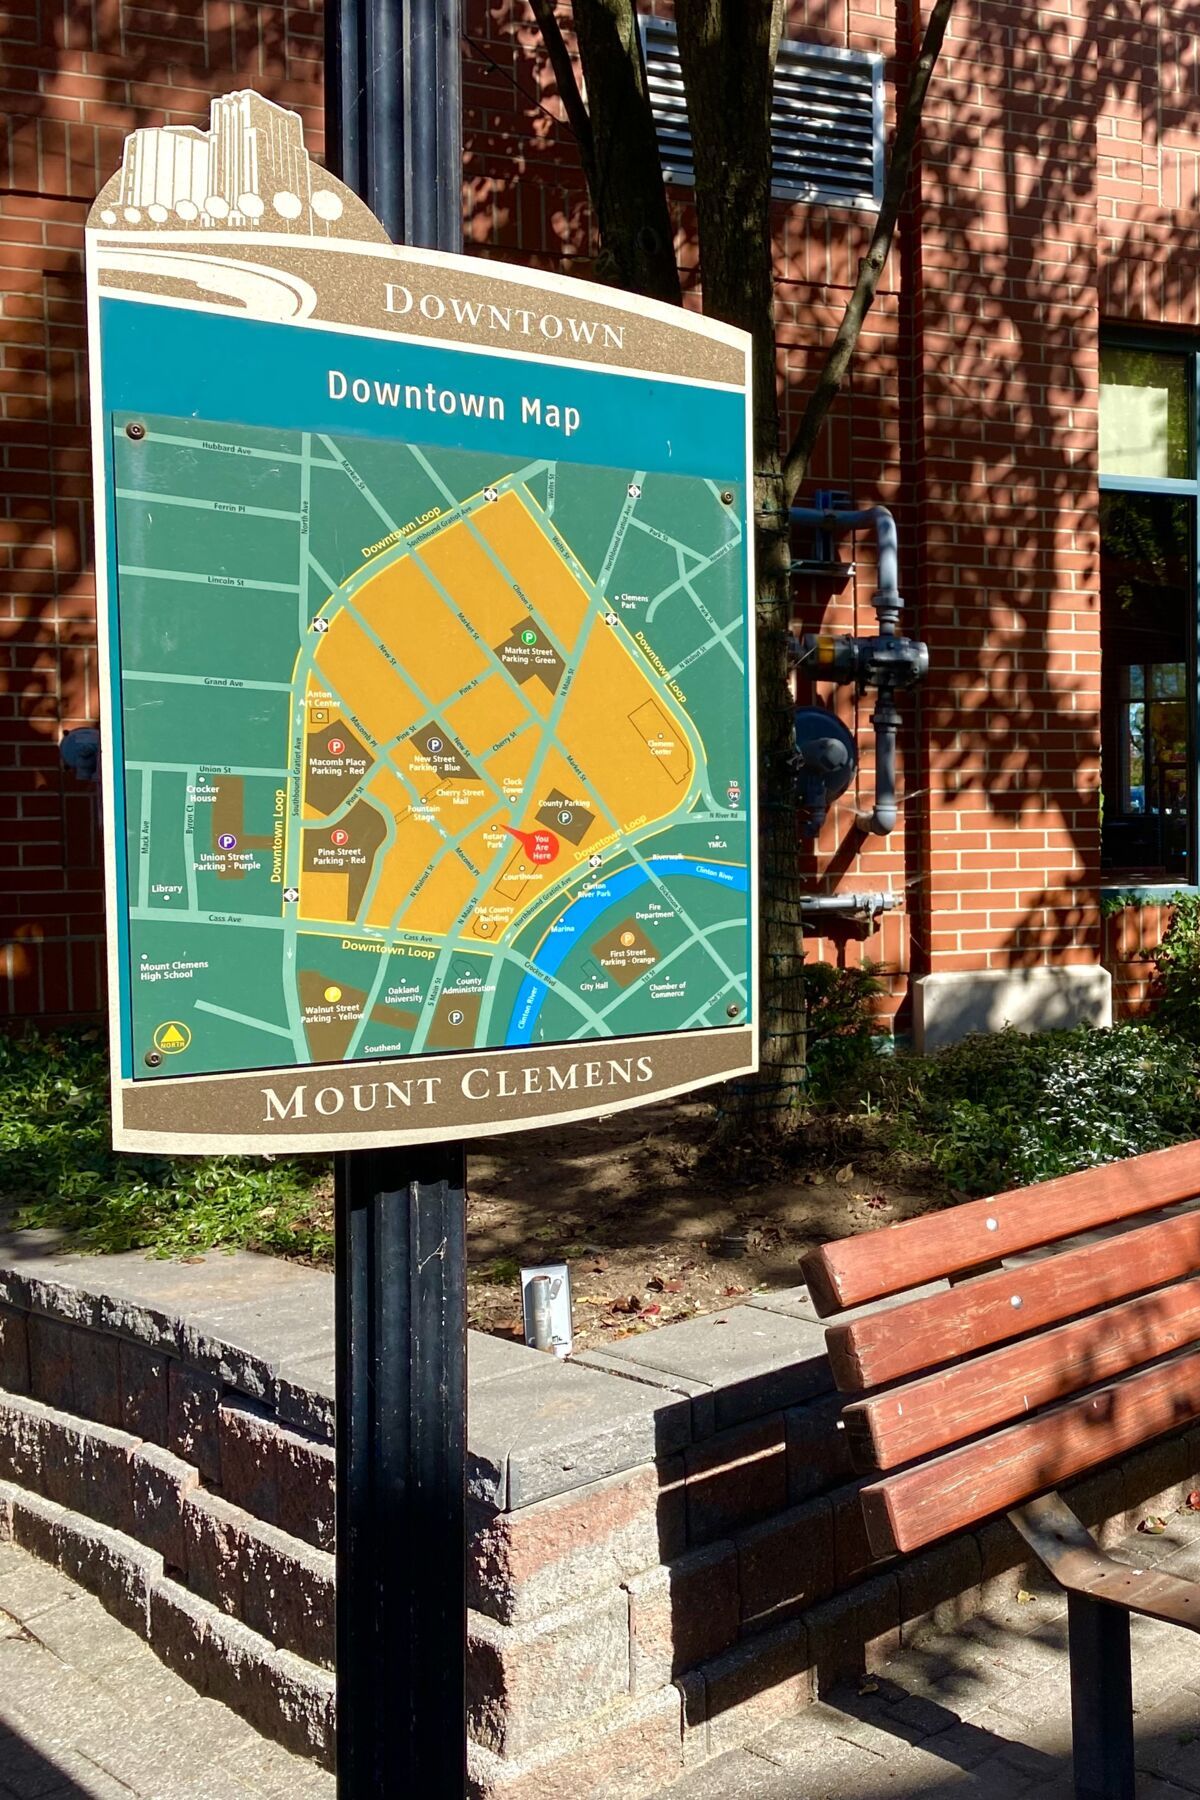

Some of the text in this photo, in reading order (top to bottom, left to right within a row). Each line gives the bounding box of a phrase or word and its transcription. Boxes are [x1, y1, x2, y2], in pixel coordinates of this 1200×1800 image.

[383, 282, 626, 350] DOWNTOWN
[328, 370, 581, 437] Downtown Map
[202, 441, 252, 455] Hubbard Ave
[341, 460, 360, 485] Market
[214, 503, 237, 512] Ferrin
[301, 517, 309, 535] North
[407, 506, 472, 548] Southbound Gratiot Ave
[362, 506, 442, 558] Downtown Loop
[650, 529, 663, 540] Park
[552, 537, 567, 555] Welts
[605, 516, 629, 572] Northbound Gratiot
[207, 576, 235, 586] Lincoln
[512, 584, 529, 607] Clinton
[621, 594, 649, 603] Clemens
[621, 602, 636, 610] Park
[699, 605, 710, 620] Park
[457, 612, 475, 636] Market
[379, 644, 393, 660] New
[505, 647, 553, 656] Market Street
[502, 655, 529, 665] Parking
[684, 650, 702, 667] Walnut
[635, 631, 687, 703] Downtown Loop
[204, 678, 228, 686] Grand
[562, 676, 572, 691] Main
[459, 684, 472, 696] Pine
[299, 699, 313, 707] Art
[350, 716, 372, 743] Macomb
[396, 731, 409, 742] Pine
[454, 737, 465, 752] New
[493, 736, 511, 752] Cherry
[409, 764, 438, 773] Parking
[567, 755, 582, 776] Market
[312, 767, 365, 776] Parking Red
[292, 738, 302, 817] Southbound Gratiot Ave
[503, 778, 522, 786] Clock
[187, 785, 220, 793] Crocker
[190, 795, 217, 803] House
[346, 794, 358, 806] Pine
[538, 800, 591, 809] County Parking
[408, 805, 441, 813] Fountain
[186, 805, 194, 835] Byron Ct
[414, 814, 435, 823] Stage
[141, 821, 150, 854] Mack Ave
[271, 789, 287, 883] Downtown Loop
[483, 833, 508, 842] Rotary
[574, 815, 647, 861] Downtown Loop
[200, 853, 253, 862] Union Street
[337, 848, 362, 856] Street
[313, 856, 366, 866] Parking Red
[455, 847, 475, 872] Macomb
[193, 861, 261, 872] Parking Purple
[696, 866, 734, 881] Clinton River
[414, 871, 431, 892] Walnut
[152, 885, 183, 894] Library
[578, 891, 595, 899] River
[514, 885, 561, 928] Northbound Gratiot
[462, 904, 474, 921] Main
[636, 911, 675, 920] Department
[551, 925, 575, 933] Marina
[404, 934, 433, 943] Cass Ave
[342, 940, 436, 961] Downtown Loop
[626, 949, 647, 957] Street
[140, 961, 209, 972] Mount Clemens
[601, 957, 656, 967] Parking Orange
[140, 970, 193, 982] High School
[524, 961, 545, 980] Crocker
[456, 978, 482, 986] County
[580, 982, 609, 992] City Hall
[650, 981, 687, 991] Chamber of
[388, 986, 420, 995] Oakland
[429, 985, 440, 1000] Main
[443, 985, 496, 995] Administration
[651, 991, 685, 999] Commerce
[385, 994, 423, 1004] University
[306, 1004, 360, 1014] Walnut Street
[518, 986, 538, 1030] Clinton River
[301, 1012, 365, 1024] Parking Yellow
[365, 1043, 401, 1053] Southend
[260, 1055, 654, 1122] MOUNT CLEMENS
